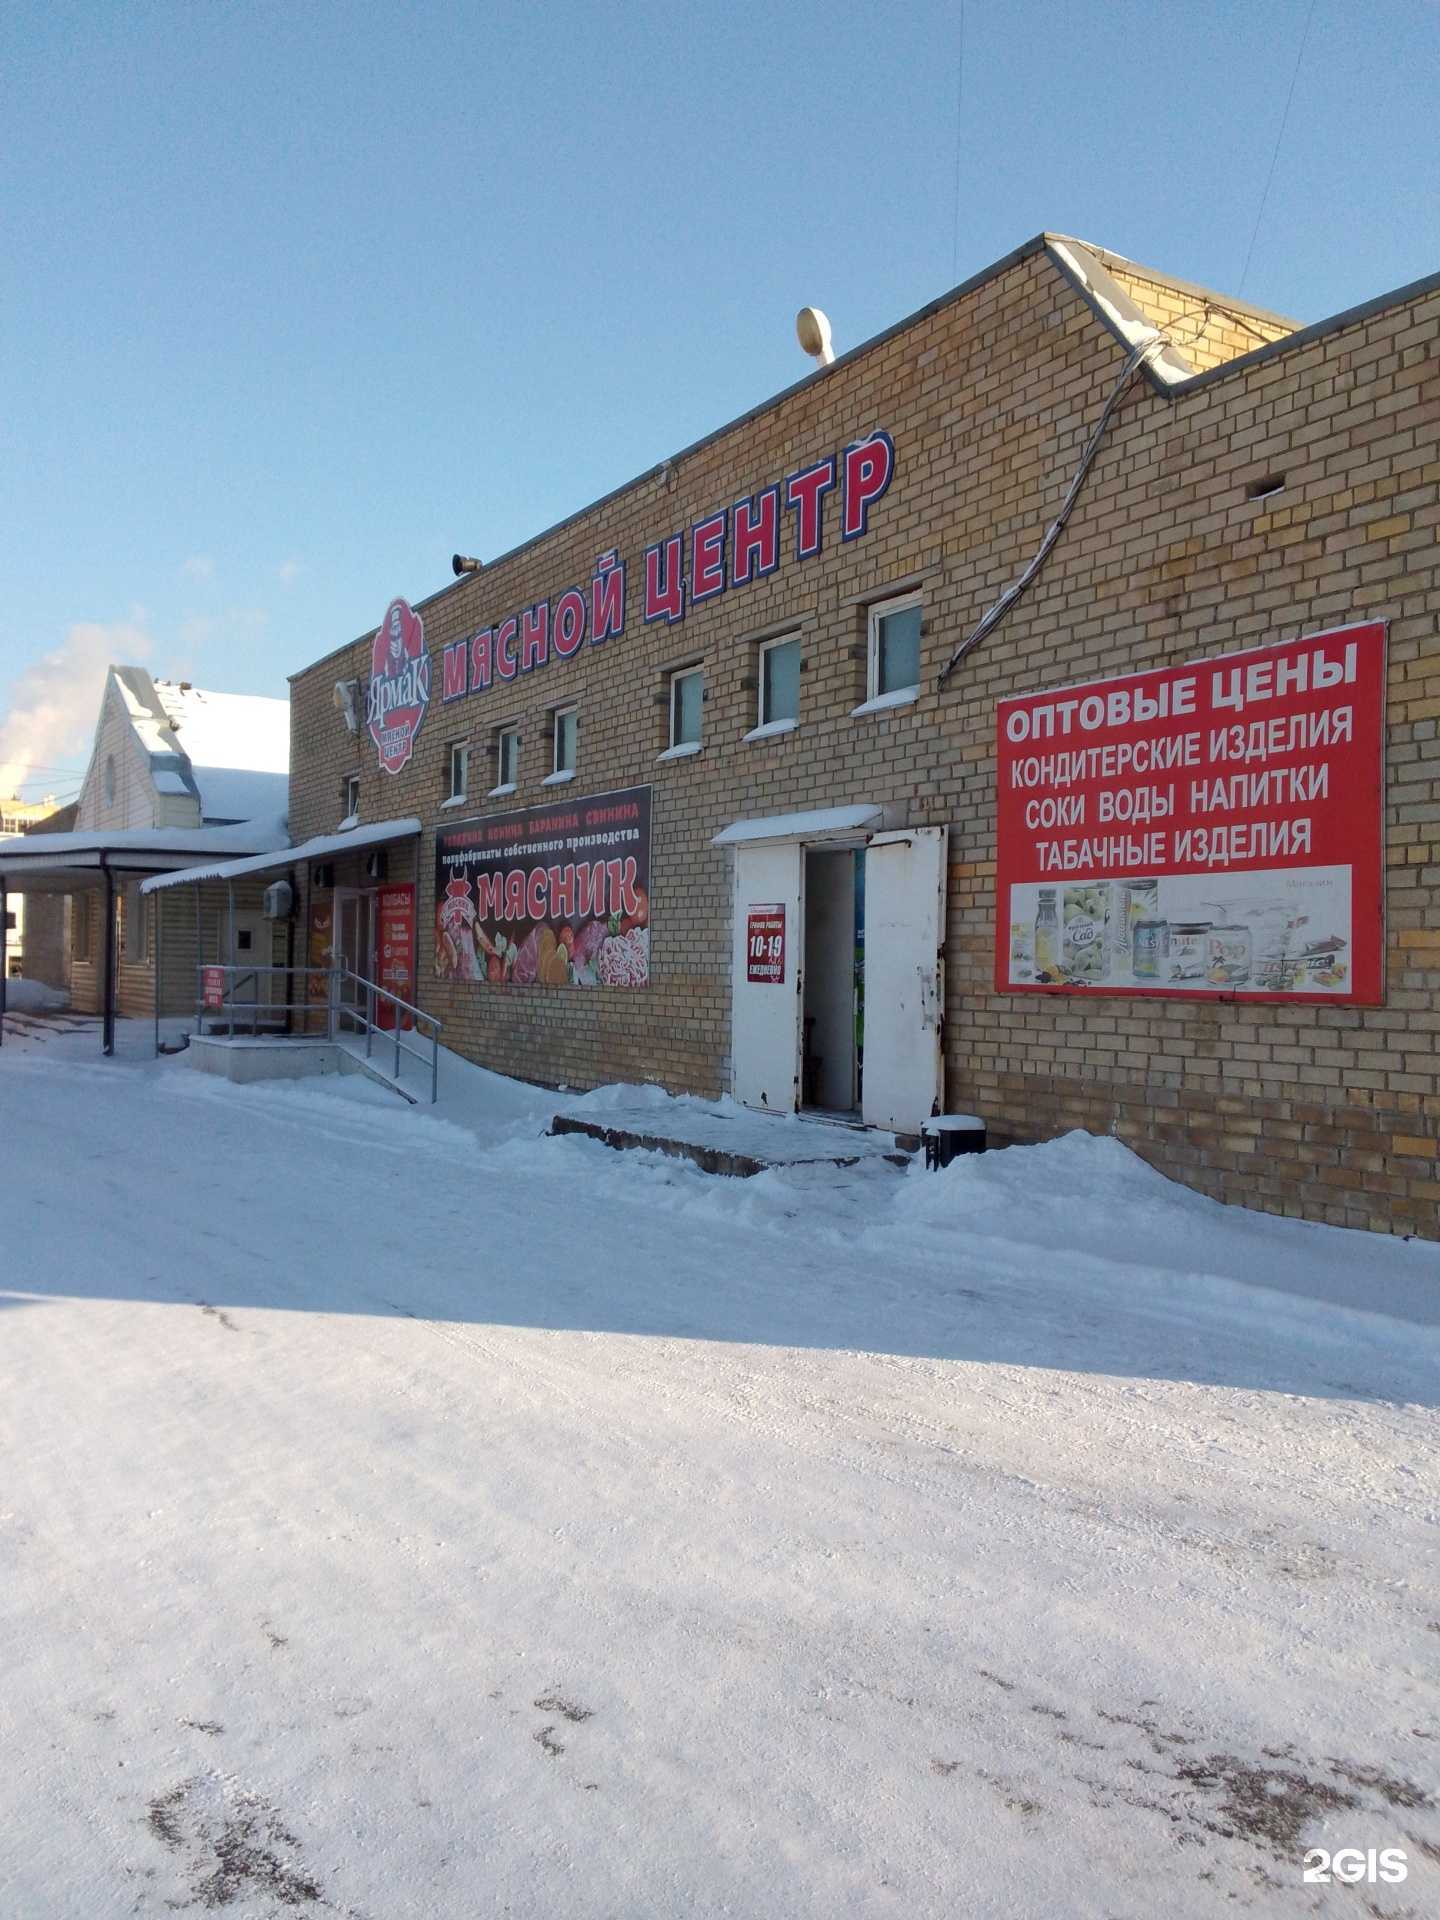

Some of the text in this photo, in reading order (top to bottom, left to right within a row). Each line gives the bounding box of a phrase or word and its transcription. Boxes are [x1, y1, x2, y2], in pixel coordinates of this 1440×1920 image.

[441, 429, 896, 703] МЯСНОЙ ЦЕНТР
[1006, 643, 1358, 743] ОПТОВЫЕ ЦЕНЫ
[1011, 706, 1353, 789] КОНДИТЕРСКИЕ ИЗДЕЛИЯ
[529, 814, 579, 835] БАРАНИНА
[586, 803, 639, 826] СВИНИНА
[1025, 763, 1329, 829] СОКИ ВОДЫ НАПИТКИ
[442, 828, 640, 867] полуфабрикаты собственного производства
[1035, 818, 1312, 872] ТАБАЧНЫЕ ИЗДЕЛИЯ
[476, 856, 642, 922] МЯСНИК
[750, 935, 783, 957] 10-19
